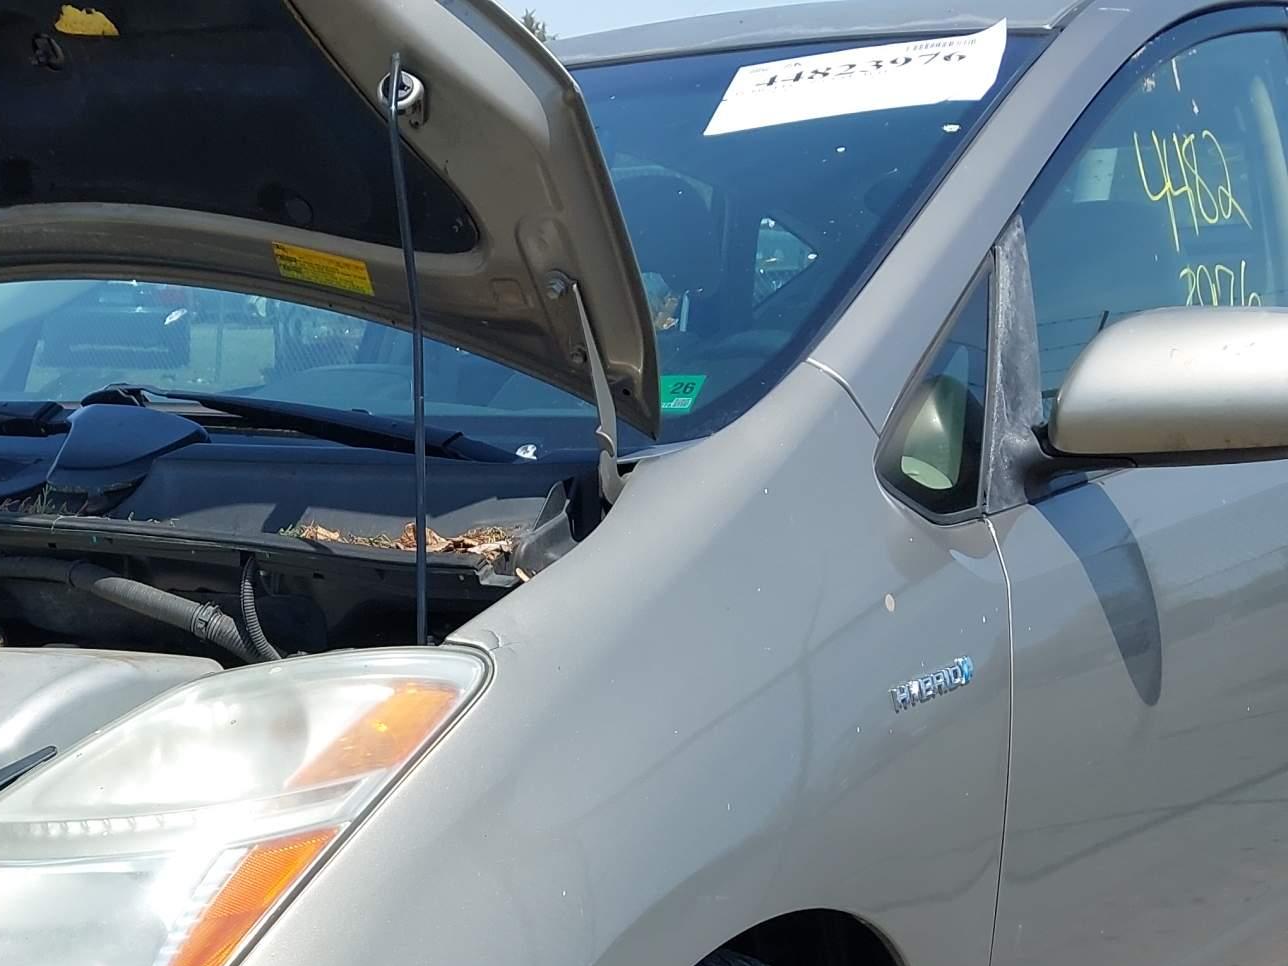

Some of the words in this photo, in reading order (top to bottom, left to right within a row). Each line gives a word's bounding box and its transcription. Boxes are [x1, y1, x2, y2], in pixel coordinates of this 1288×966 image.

[754, 50, 967, 87] 44823976
[1133, 128, 1254, 253] 4482
[669, 381, 697, 395] 26
